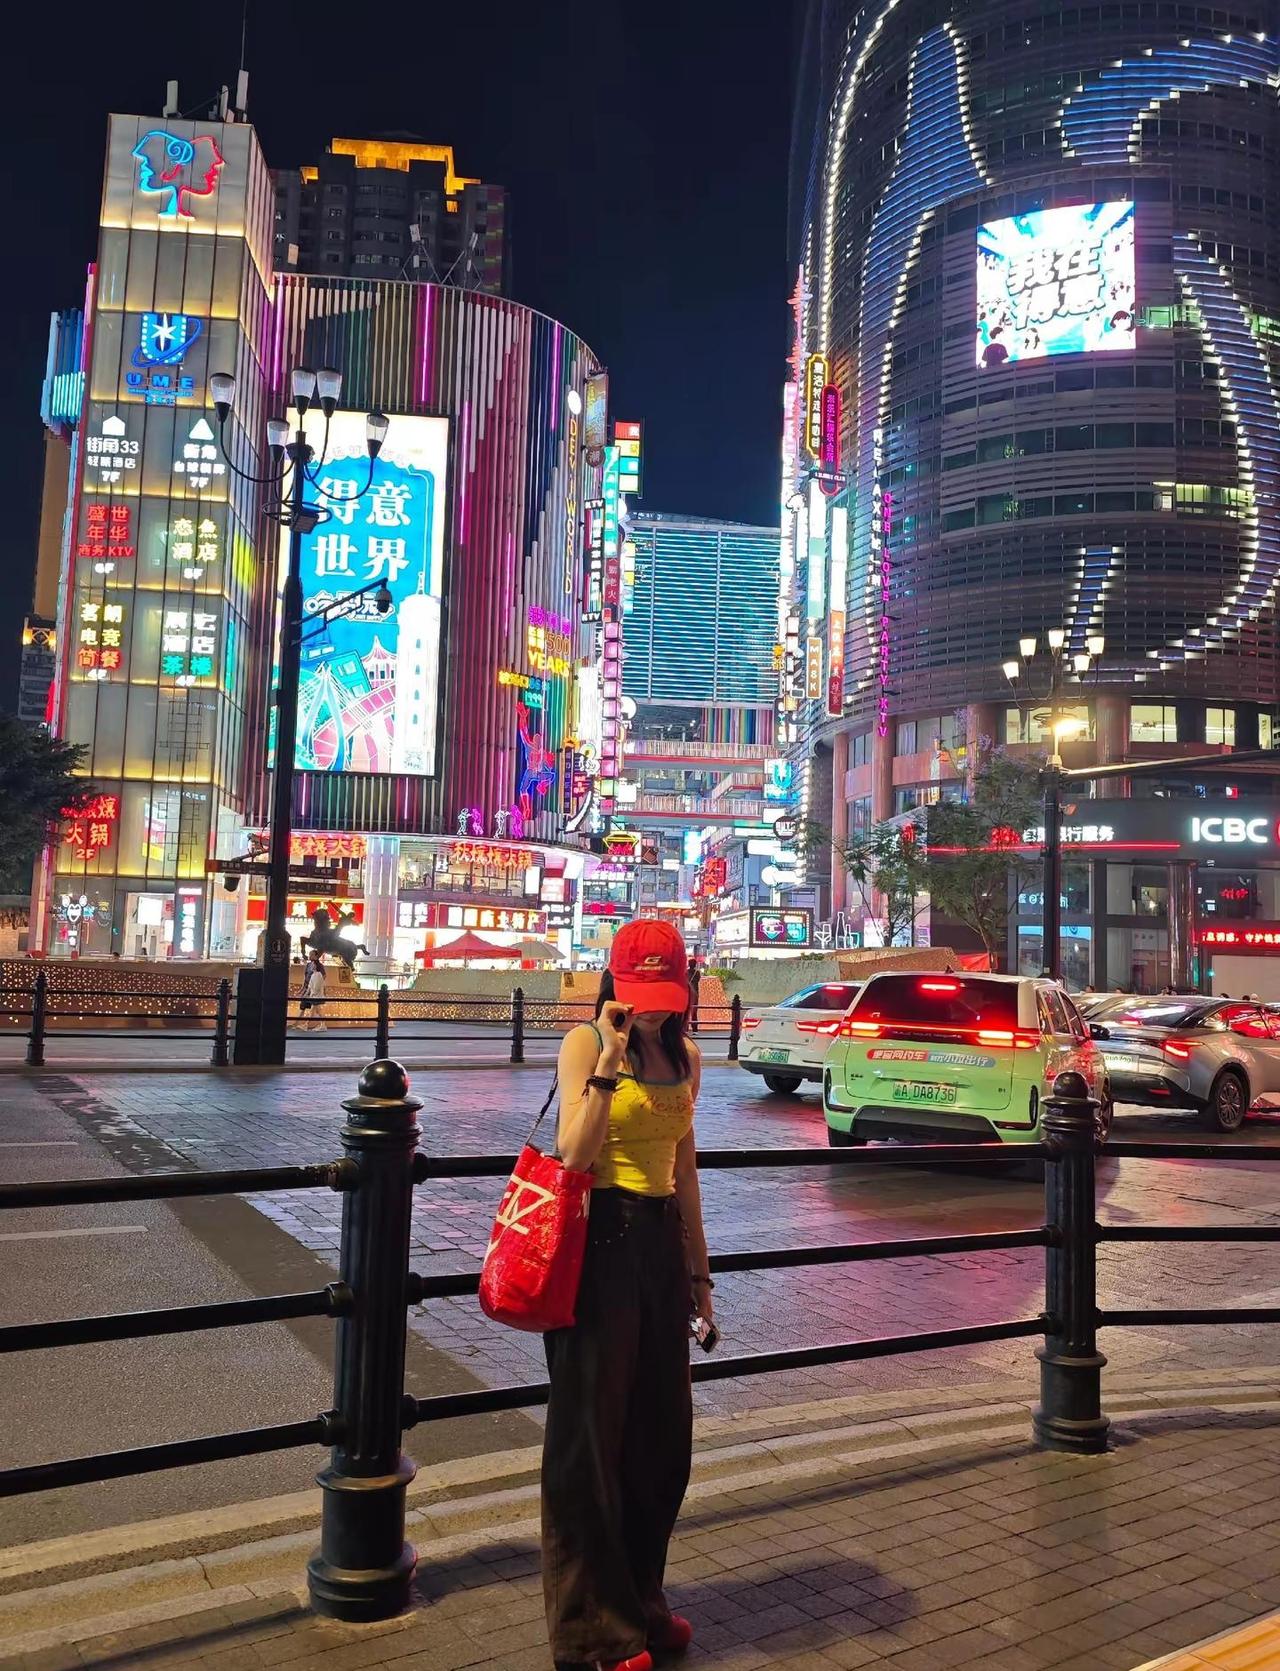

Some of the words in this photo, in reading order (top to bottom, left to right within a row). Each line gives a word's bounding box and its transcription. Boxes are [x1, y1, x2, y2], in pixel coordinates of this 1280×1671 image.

[126, 372, 195, 390] UME
[87, 505, 129, 522] 盛世
[314, 476, 413, 527] 得意
[883, 493, 893, 532] ONE
[86, 524, 128, 542] 年华
[565, 497, 576, 594] WORLD
[172, 541, 218, 562] 酒店
[311, 533, 410, 583] 世界
[881, 553, 891, 602] LOVE
[80, 628, 121, 647] 电竞
[78, 648, 120, 668] 简餐
[528, 650, 570, 677] YEARS
[879, 617, 889, 685] PARTY
[809, 646, 820, 691] MASK
[878, 699, 889, 737] KTV
[66, 823, 110, 846] 火锅
[1191, 817, 1268, 843] ICBC
[76, 849, 95, 859] 2F
